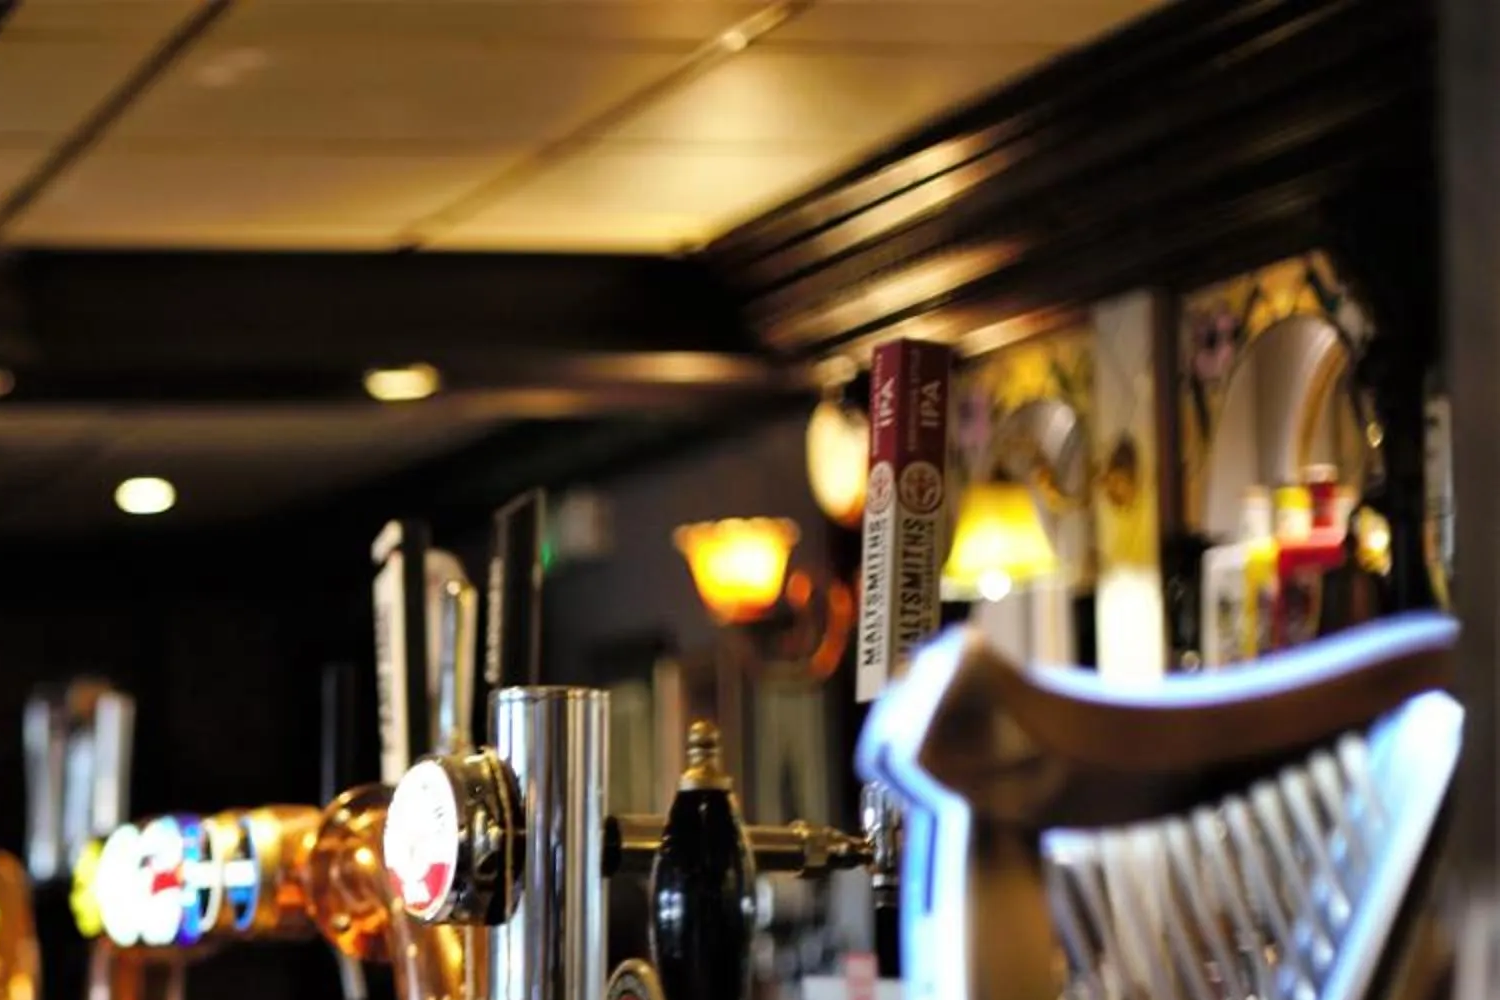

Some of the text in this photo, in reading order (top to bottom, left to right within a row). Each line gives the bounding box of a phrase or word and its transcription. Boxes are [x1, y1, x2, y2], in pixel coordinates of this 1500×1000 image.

[878, 376, 895, 427] IPA
[921, 380, 941, 428] IPA
[863, 518, 882, 667] MALTSMITHS
